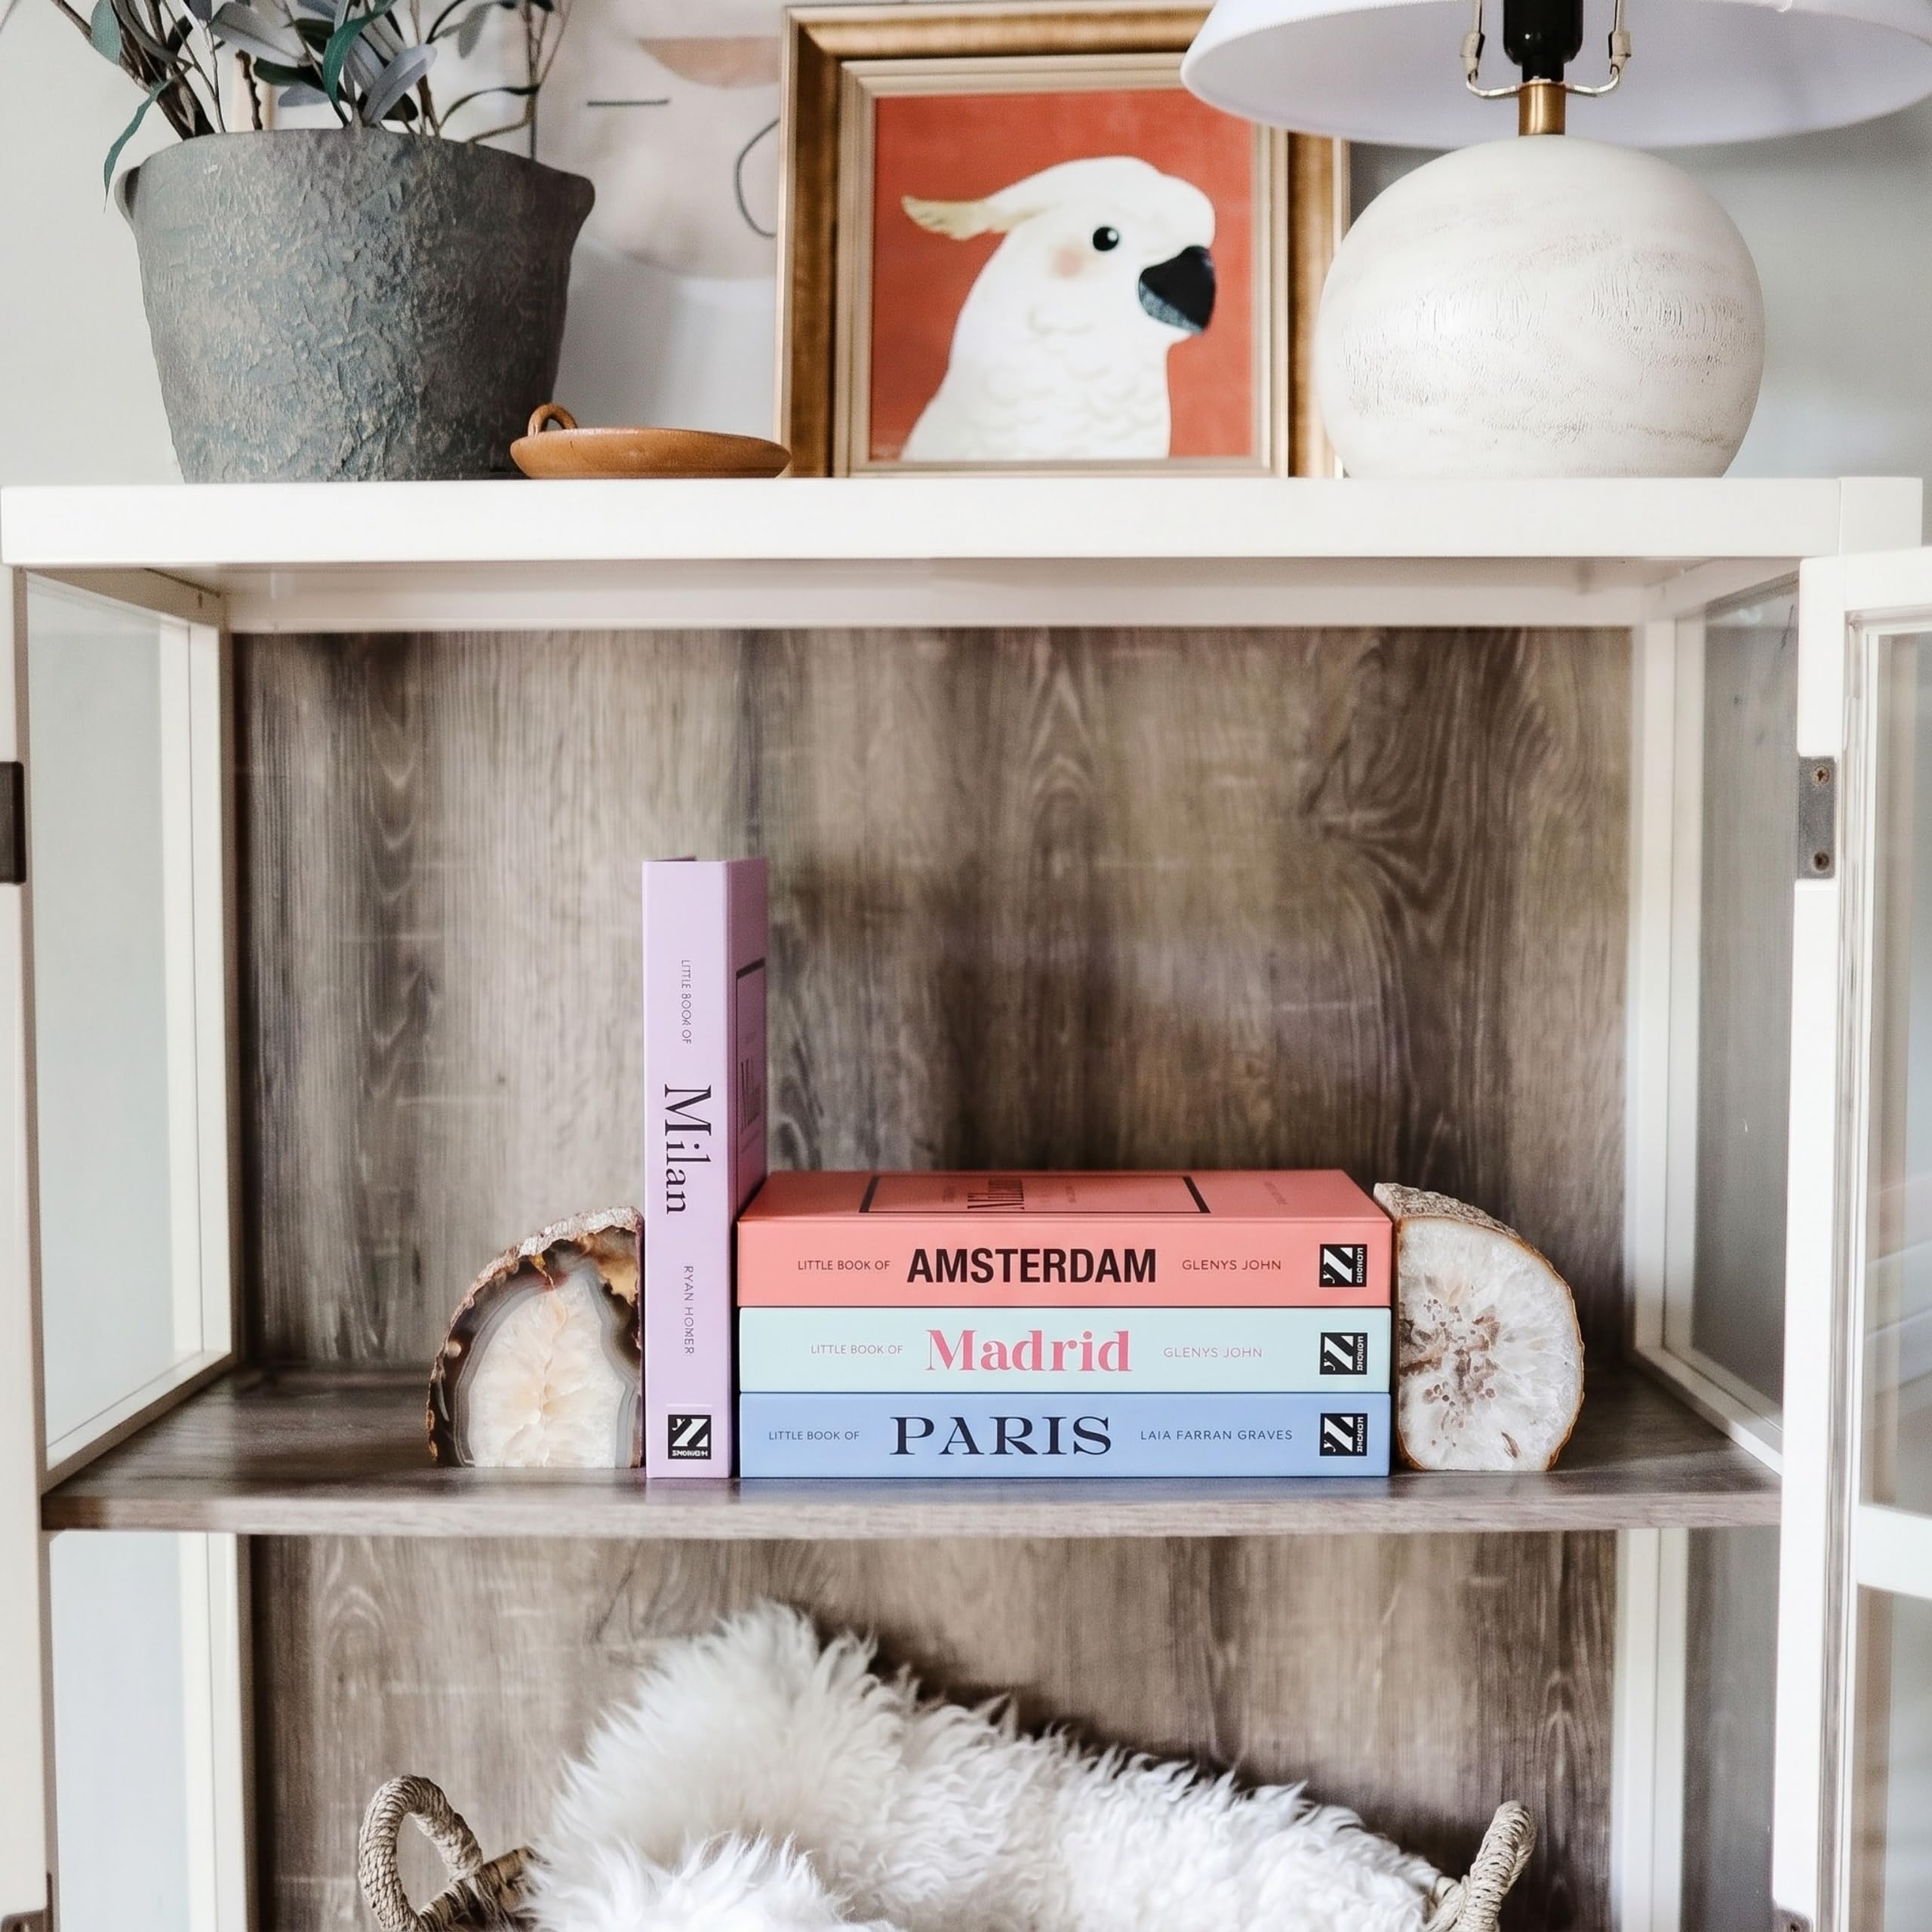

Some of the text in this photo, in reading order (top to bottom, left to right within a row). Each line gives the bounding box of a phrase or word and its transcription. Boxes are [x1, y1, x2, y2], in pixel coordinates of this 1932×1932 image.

[681, 959, 691, 989] LITTLE
[681, 1029, 692, 1044] OF
[664, 1084, 712, 1215] Milan
[683, 1265, 694, 1301] RYAN
[798, 1247, 1281, 1284] LITTLE BOOK OF AMSTERDAM GLENYS JOHN
[684, 1306, 695, 1354] HOMER
[811, 1329, 1263, 1372] LITTLE BOOK OF Madrid GLENYS JOHN
[768, 1415, 1293, 1457] LITTLE BOOK OF PARIS LAIA FARRAN GRAVES
